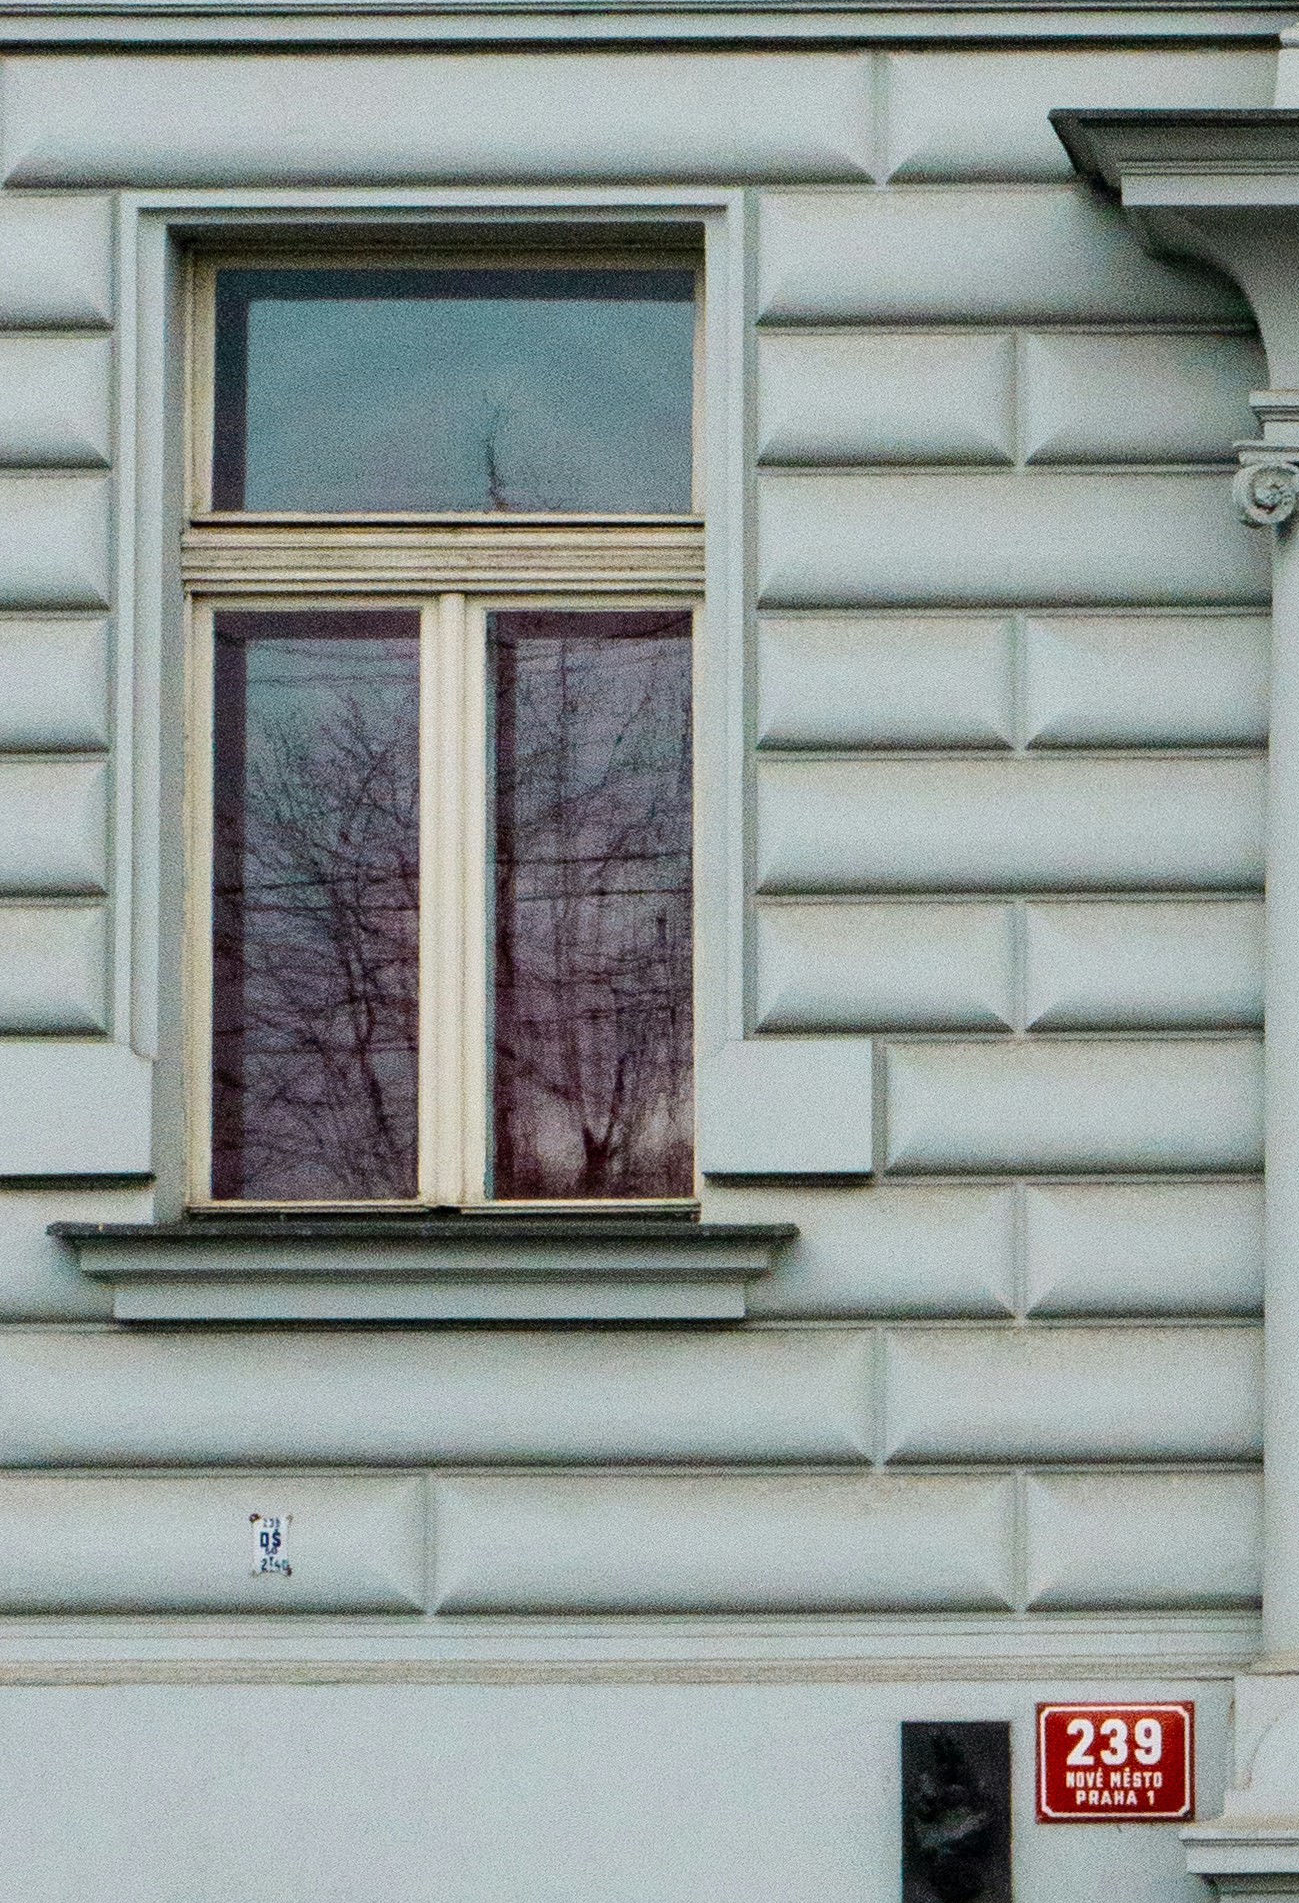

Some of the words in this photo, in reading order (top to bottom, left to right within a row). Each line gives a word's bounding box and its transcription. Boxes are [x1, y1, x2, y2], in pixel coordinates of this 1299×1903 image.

[1066, 1717, 1163, 1766] 239
[1065, 1767, 1104, 1788] NOVÉ
[1075, 1789, 1138, 1806] PRAHA
[1147, 1789, 1155, 1806] 1
